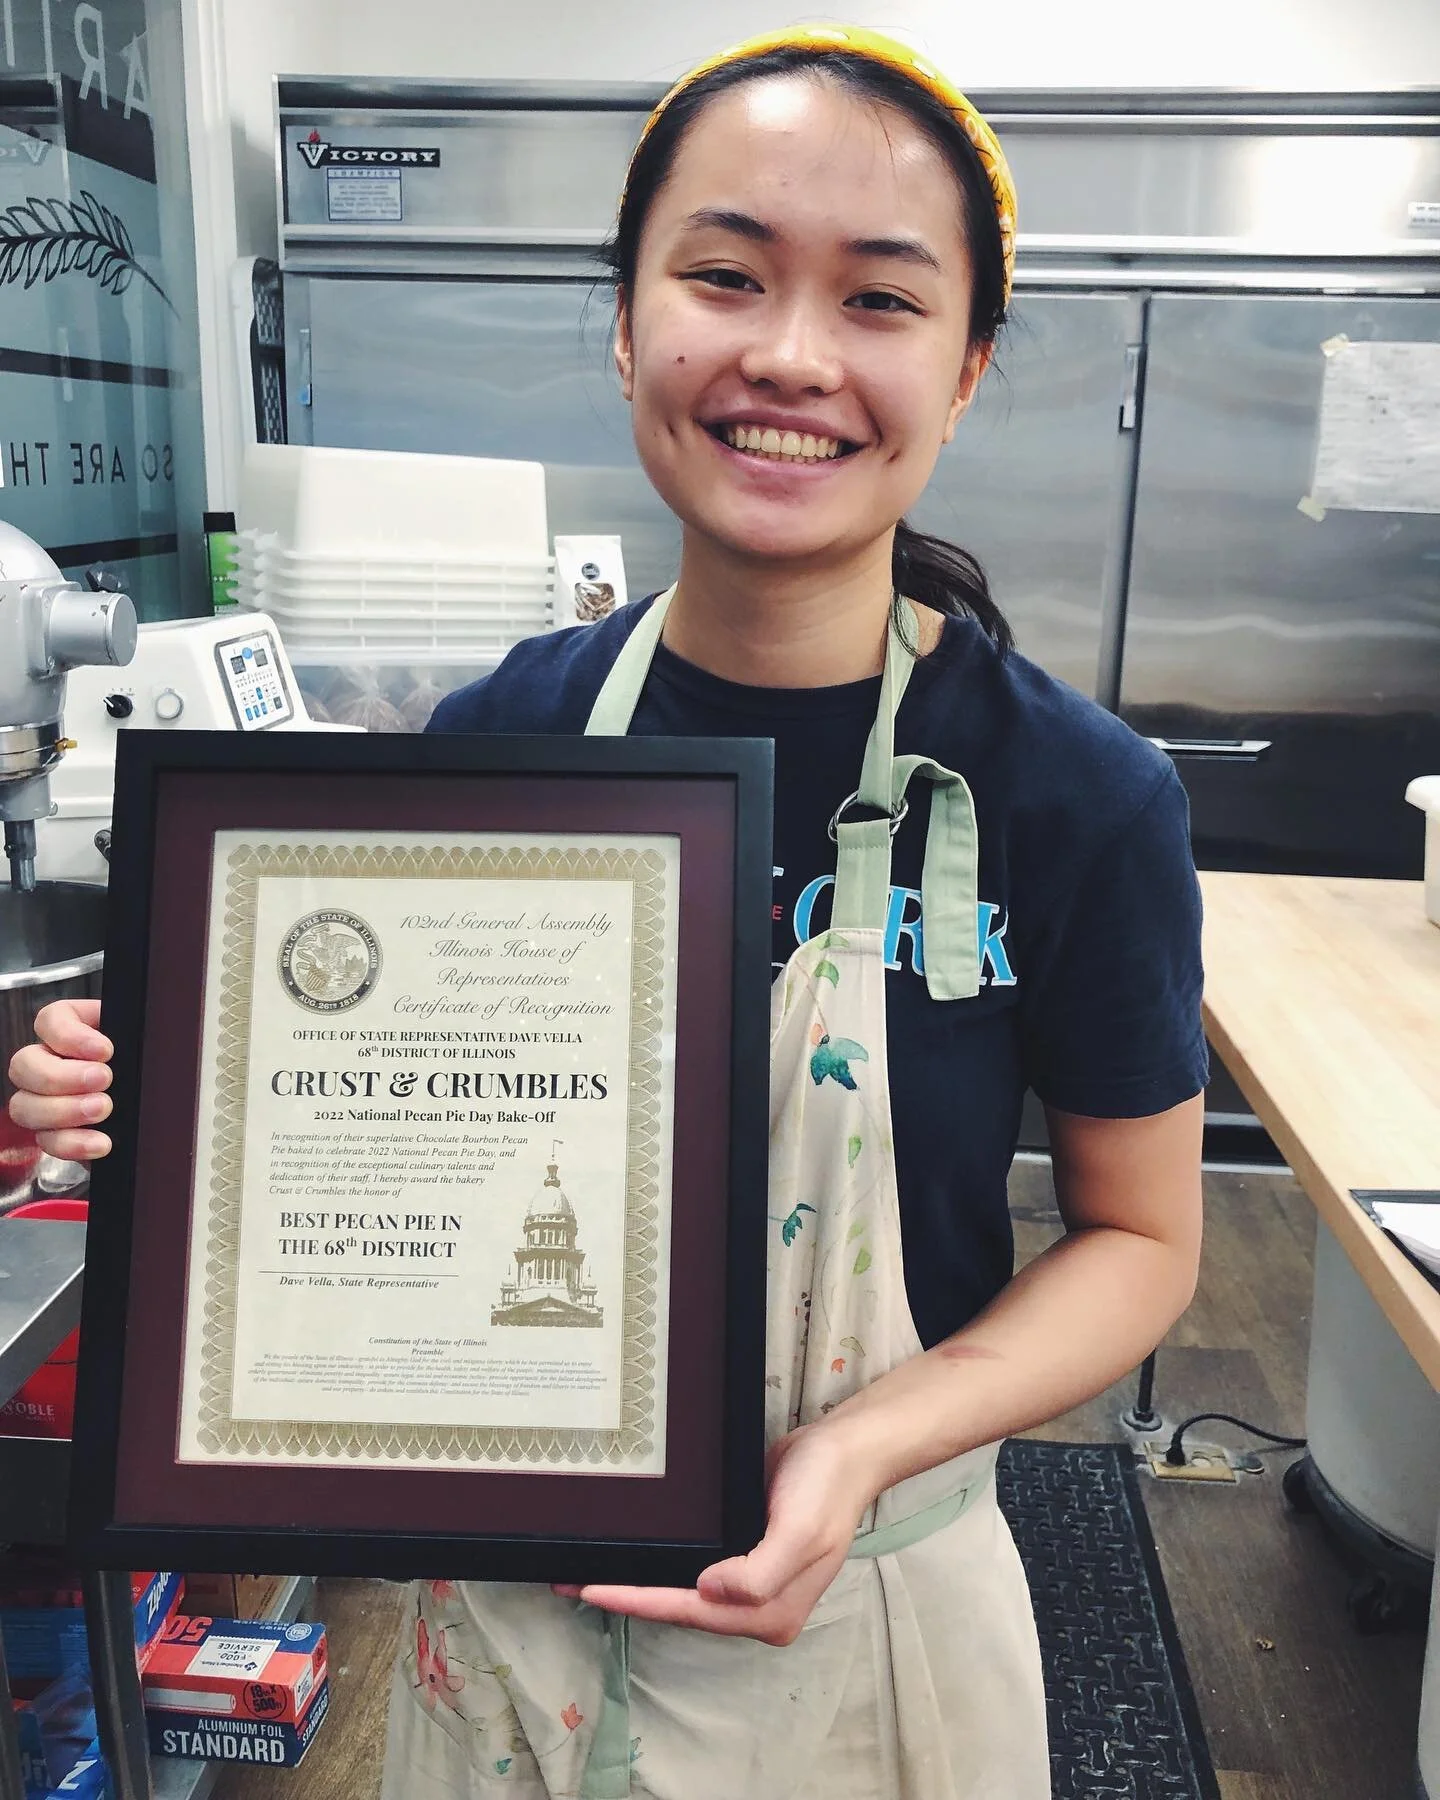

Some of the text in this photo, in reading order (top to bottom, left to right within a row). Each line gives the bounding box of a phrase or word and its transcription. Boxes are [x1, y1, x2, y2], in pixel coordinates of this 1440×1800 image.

[299, 143, 436, 166] VICTORY
[400, 912, 615, 937] 102nd General Assembly
[320, 913, 350, 923] STATE
[360, 928, 378, 969] ILLINOIS
[429, 938, 586, 964] Illinois House of
[437, 967, 570, 992] Representatives
[339, 993, 359, 1008] 1818
[393, 995, 615, 1021] Certificate of Recognition
[292, 1030, 583, 1043] OFFICE OF STATE REPRESENTATIVE DAVE VELLA
[358, 1045, 516, 1059] 68th DISTRICT OF ILLINOIS
[271, 1070, 608, 1100] CRUST & CRUMBLES
[313, 1109, 556, 1124] 2022 National Pecan Pie Day Bake-Off
[271, 1131, 528, 1144] In recognition of their superlative Chocolate Bourbon Pecan
[271, 1145, 285, 1154] Pie
[287, 1145, 314, 1154] baked
[315, 1146, 324, 1154] to
[325, 1146, 366, 1155] celebrate
[368, 1146, 390, 1156] 2022
[391, 1146, 429, 1156] National
[431, 1147, 458, 1157] Pecan
[460, 1148, 475, 1157] Pie
[499, 1149, 516, 1158] and
[280, 1159, 329, 1169] recognition
[331, 1160, 342, 1170] of
[342, 1160, 355, 1168] the
[358, 1160, 407, 1171] exceptional
[409, 1161, 445, 1172] culinary
[447, 1161, 476, 1170] talents
[477, 1162, 495, 1171] and
[269, 1172, 314, 1181] dedication
[316, 1173, 326, 1183] of
[327, 1173, 348, 1182] their
[379, 1174, 409, 1185] hereby
[410, 1174, 438, 1184] award
[440, 1175, 454, 1184] the
[455, 1175, 485, 1186] bakery
[269, 1185, 293, 1195] Crust
[305, 1186, 346, 1195] Crumbles
[348, 1187, 362, 1196] the
[363, 1187, 390, 1196] honor
[391, 1188, 402, 1199] of
[279, 1211, 462, 1231] BEST PECAN PIE IN
[278, 1236, 456, 1258] THE 68th DISTRICT
[279, 1276, 439, 1290] Dave Vella, State Representative
[368, 1337, 411, 1345] Constitution
[412, 1338, 421, 1347] of
[434, 1338, 452, 1346] State
[453, 1338, 461, 1347] of
[462, 1338, 488, 1346] Illinois
[412, 1348, 444, 1356] Preamble
[217, 1642, 261, 1652] SERVICE
[220, 1652, 246, 1661] FOOD
[198, 1719, 285, 1738] ALUMINUM FOIL
[163, 1729, 285, 1763] STANDARD
